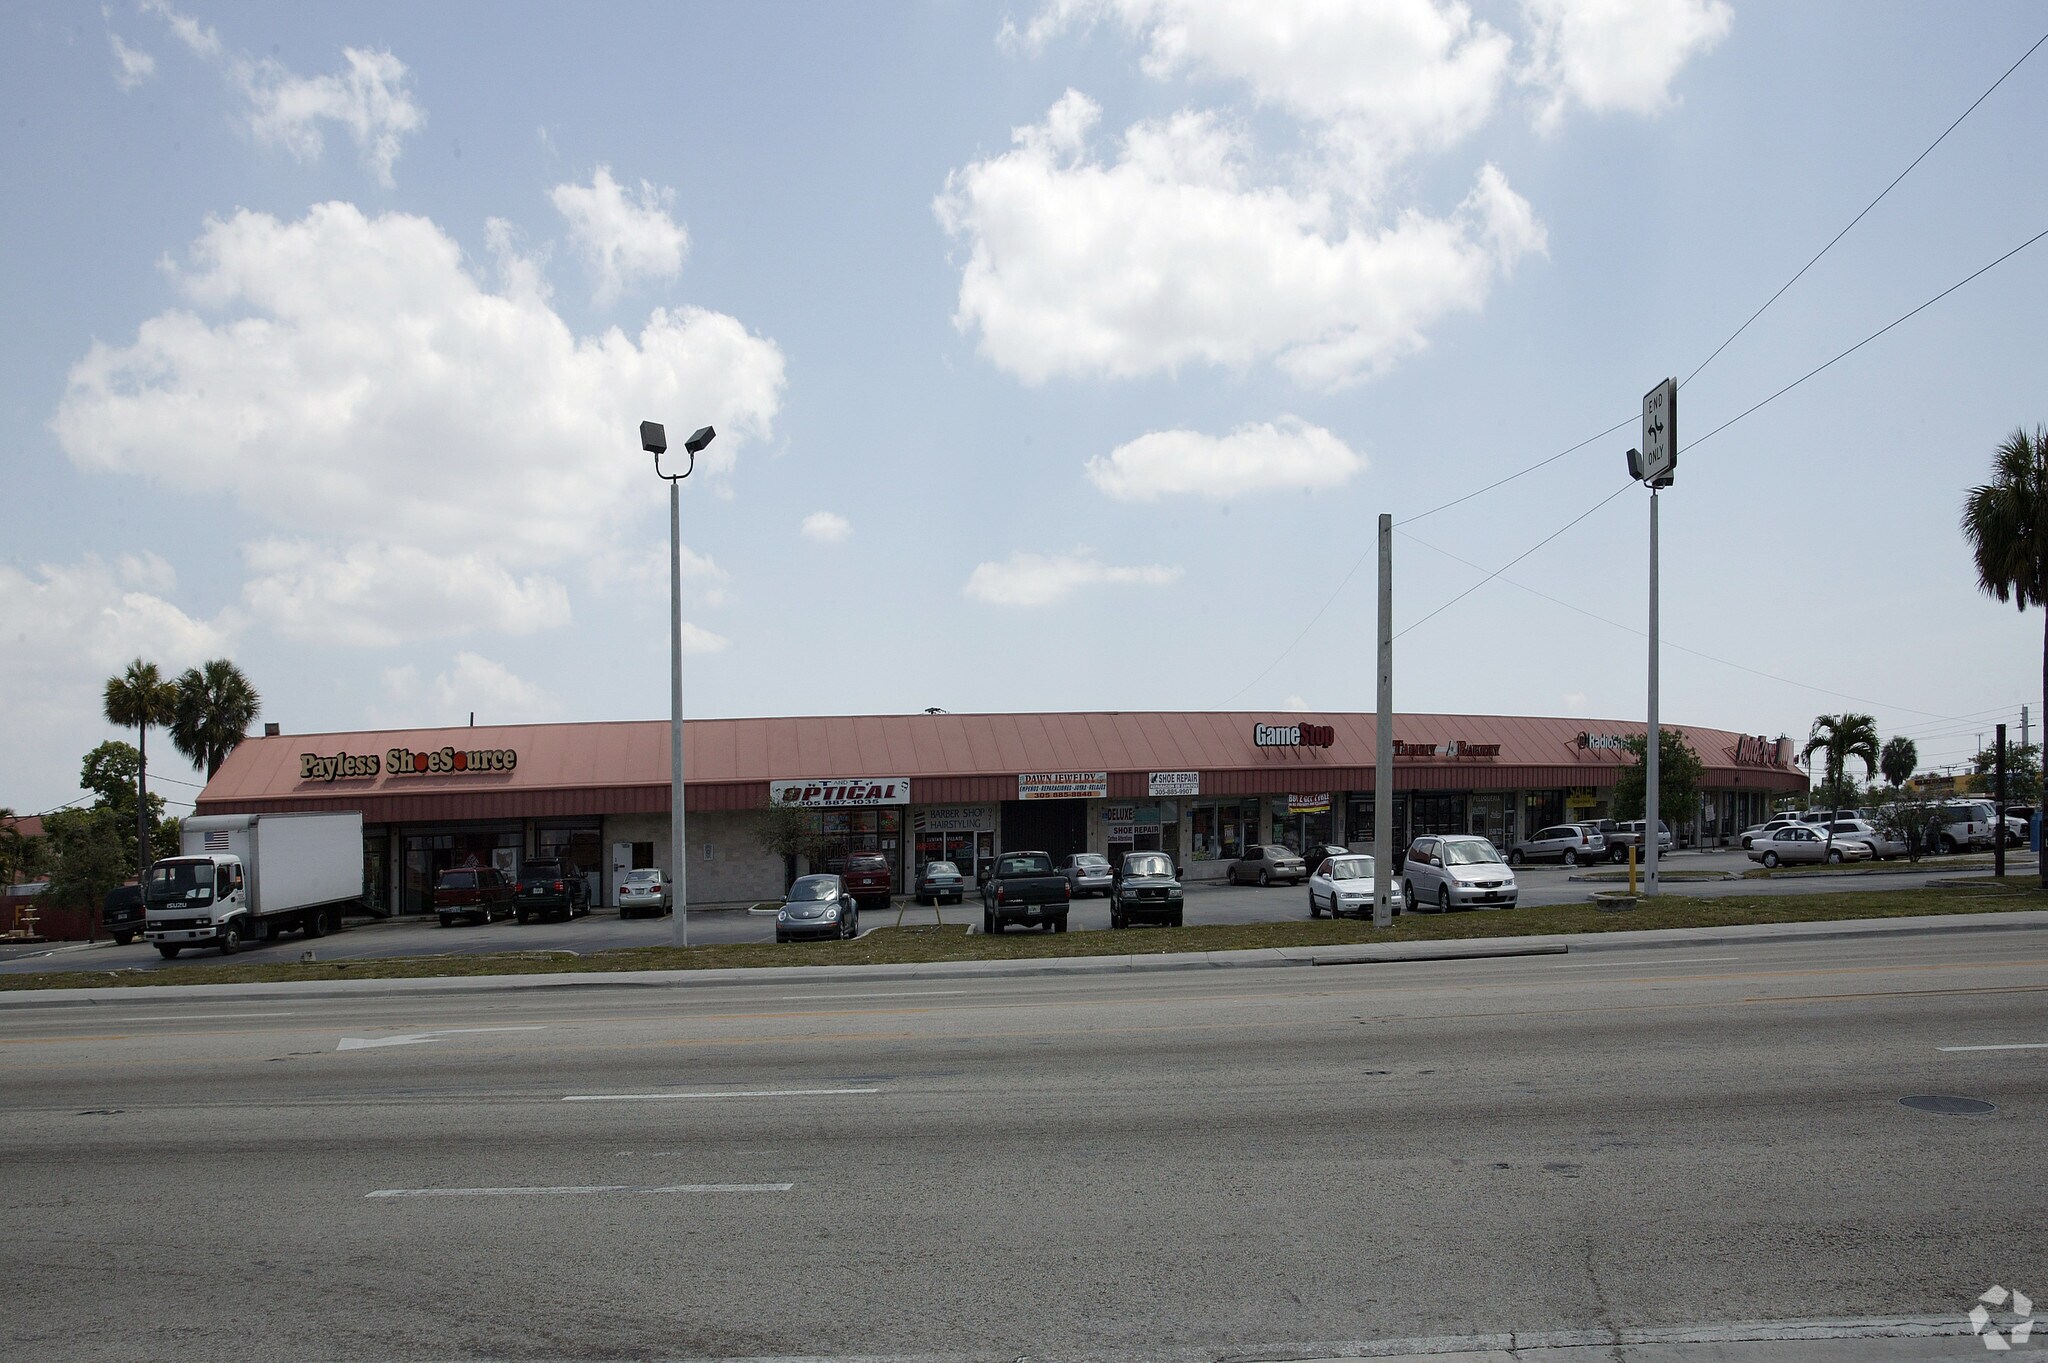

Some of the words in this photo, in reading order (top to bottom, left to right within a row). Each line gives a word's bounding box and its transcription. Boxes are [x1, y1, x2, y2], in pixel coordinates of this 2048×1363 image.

[1648, 393, 1663, 414] END
[1648, 444, 1664, 465] ONLY
[1254, 722, 1335, 748] GameStop
[301, 752, 380, 782] Payless
[386, 747, 517, 775] ShoeSource
[1025, 774, 1052, 785] DAWN
[1055, 773, 1097, 784] JEWELRY
[1159, 774, 1175, 783] SHOE
[1177, 773, 1198, 782] REPAIR
[782, 784, 896, 801] OPTICAL
[930, 809, 960, 819] BARBER
[963, 808, 985, 818] SHOP
[1108, 808, 1133, 820] DELUXE
[930, 819, 981, 829] HAIRSTYLING
[1114, 826, 1133, 834] SHOE
[1134, 826, 1159, 834] REPAIR
